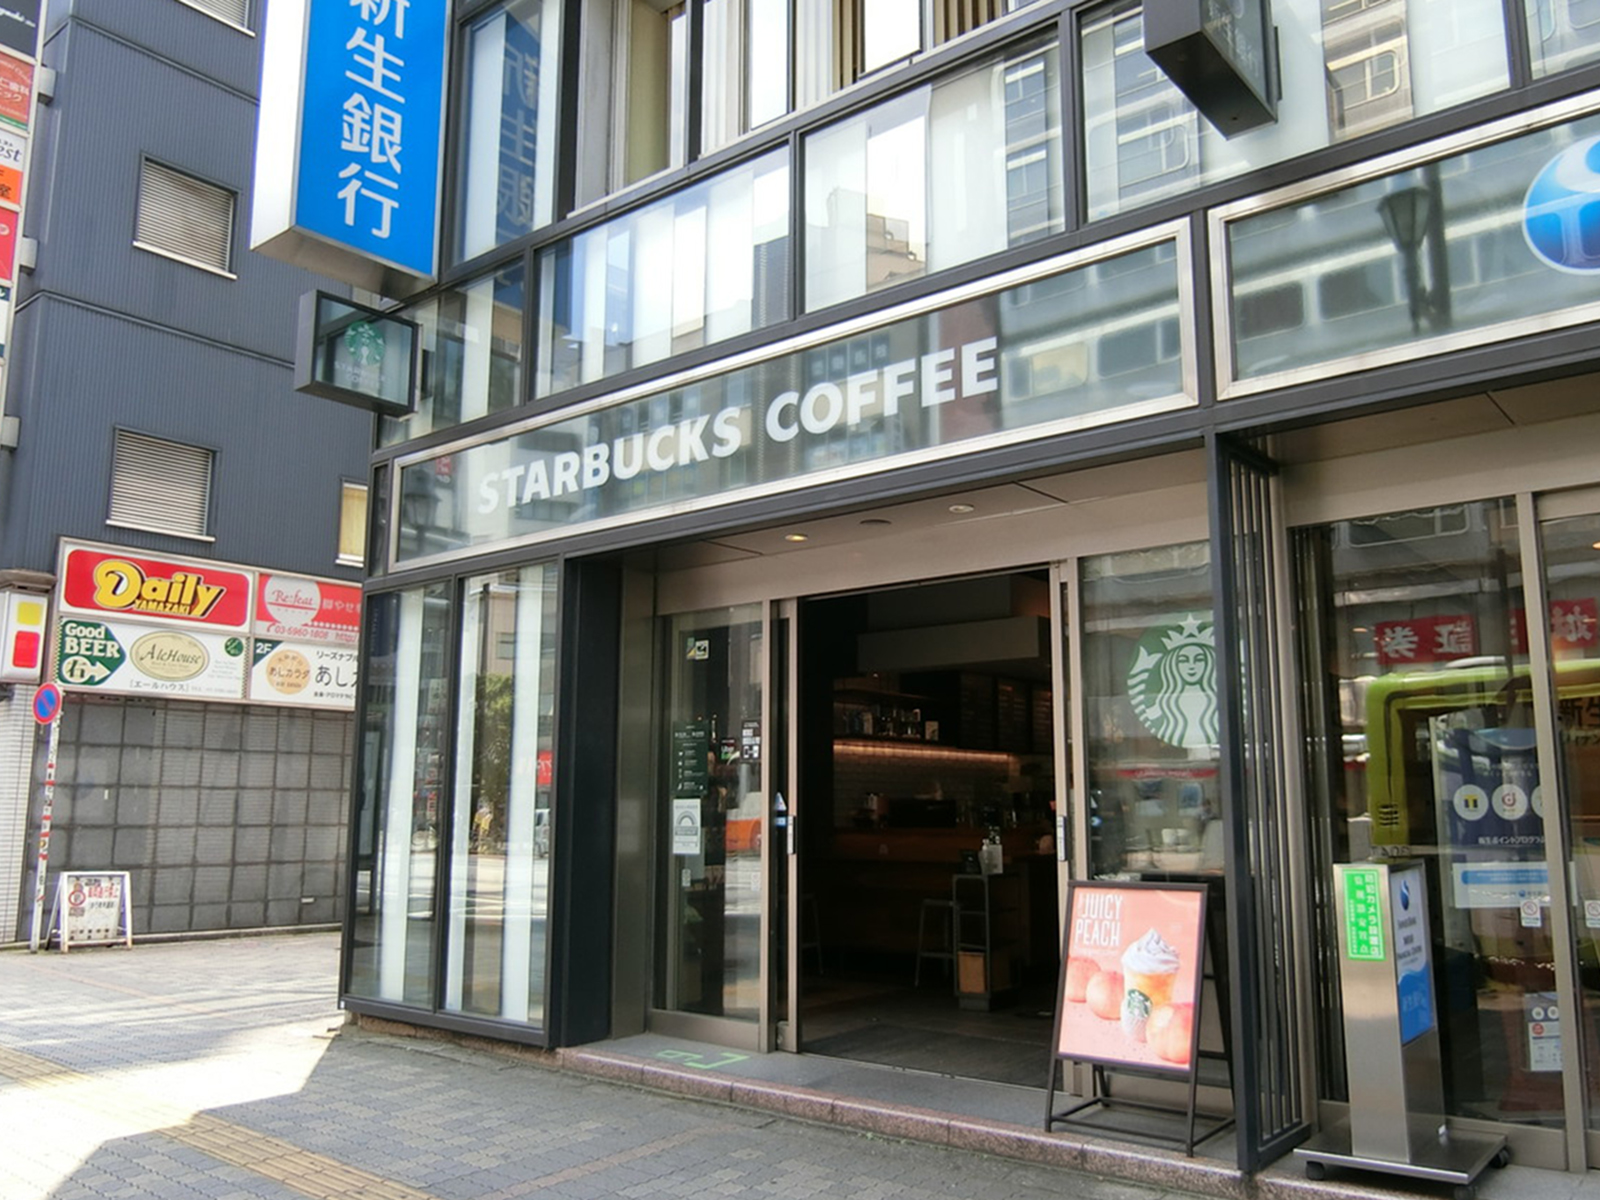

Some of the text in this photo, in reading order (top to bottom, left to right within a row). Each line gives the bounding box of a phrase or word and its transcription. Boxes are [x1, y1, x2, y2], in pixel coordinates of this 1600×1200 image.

[477, 336, 998, 514] STARBUCKS COFFEE
[94, 559, 226, 618] Daily
[135, 599, 190, 615] YAMAZAKI
[65, 622, 106, 639] Good
[64, 637, 121, 658] BEER
[255, 642, 272, 655] 2F
[1080, 893, 1122, 919] JUICY
[1075, 919, 1120, 946] PEACH
